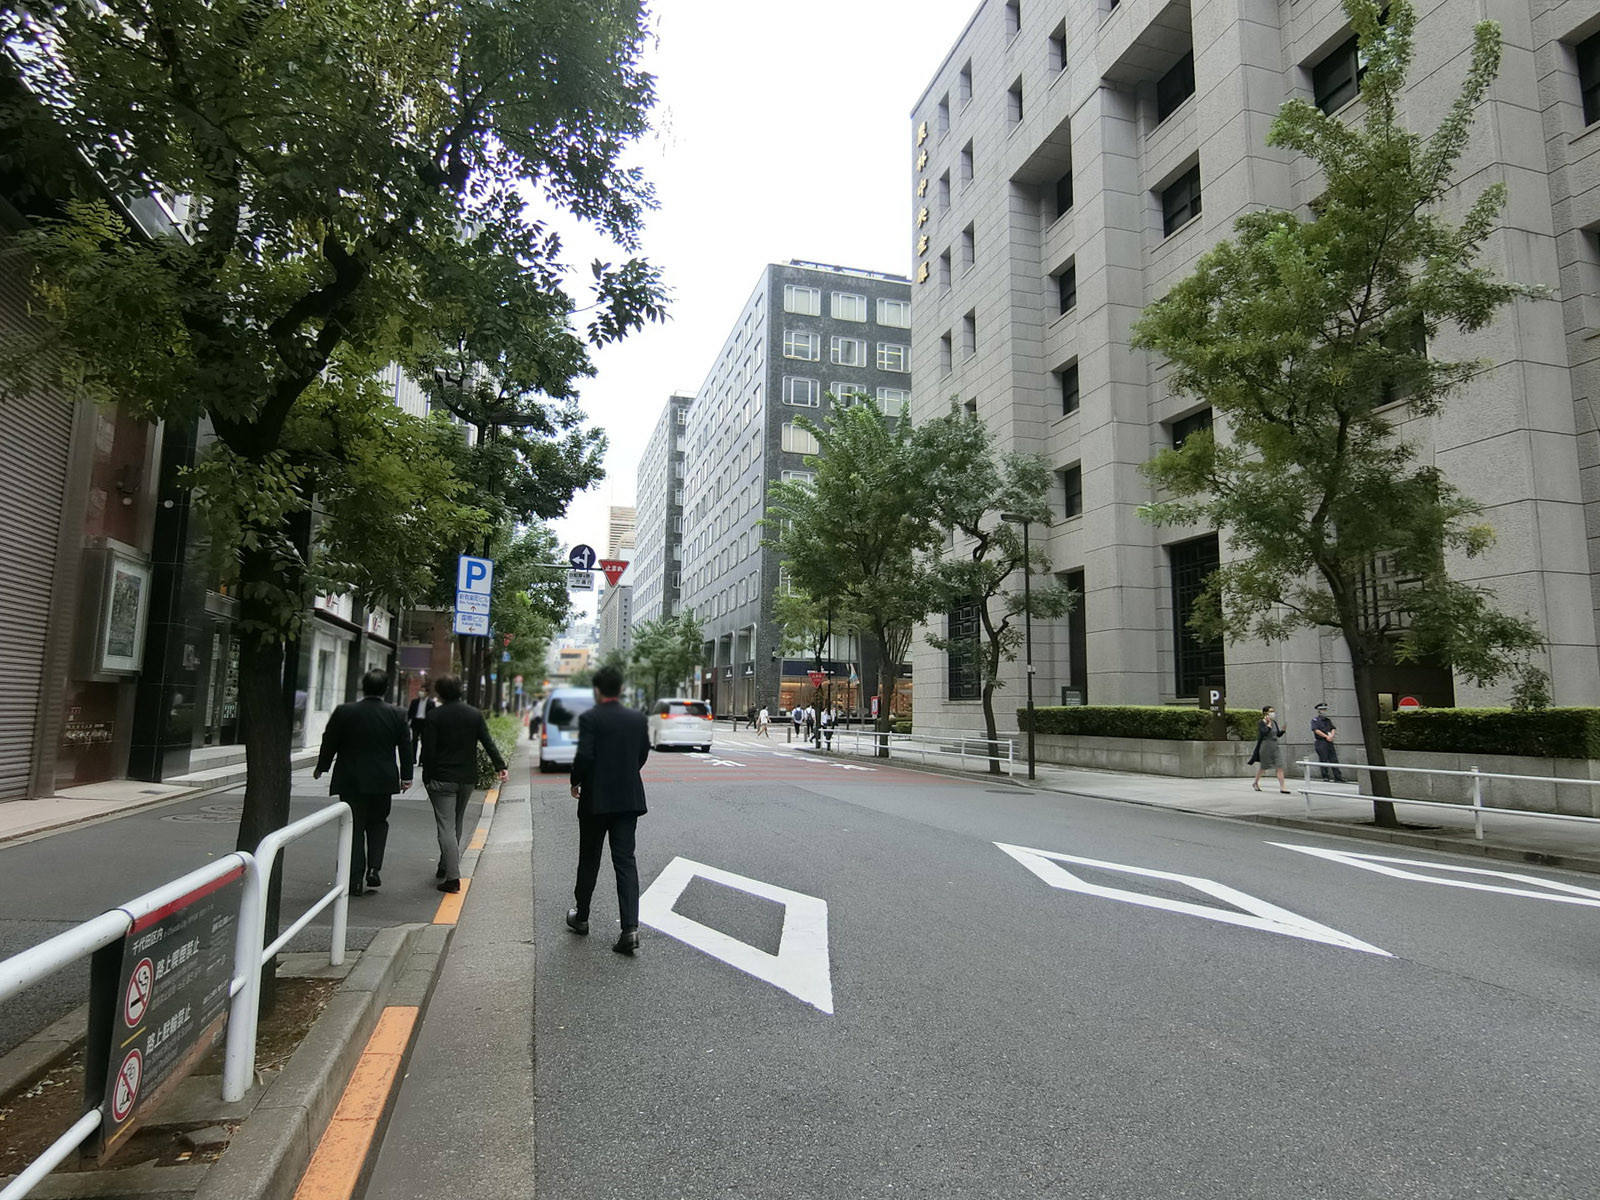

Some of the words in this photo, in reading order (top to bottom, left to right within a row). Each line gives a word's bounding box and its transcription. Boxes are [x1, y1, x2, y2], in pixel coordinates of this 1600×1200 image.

[465, 560, 487, 589] P
[1209, 690, 1220, 704] P
[132, 927, 164, 956] 千代田区内
